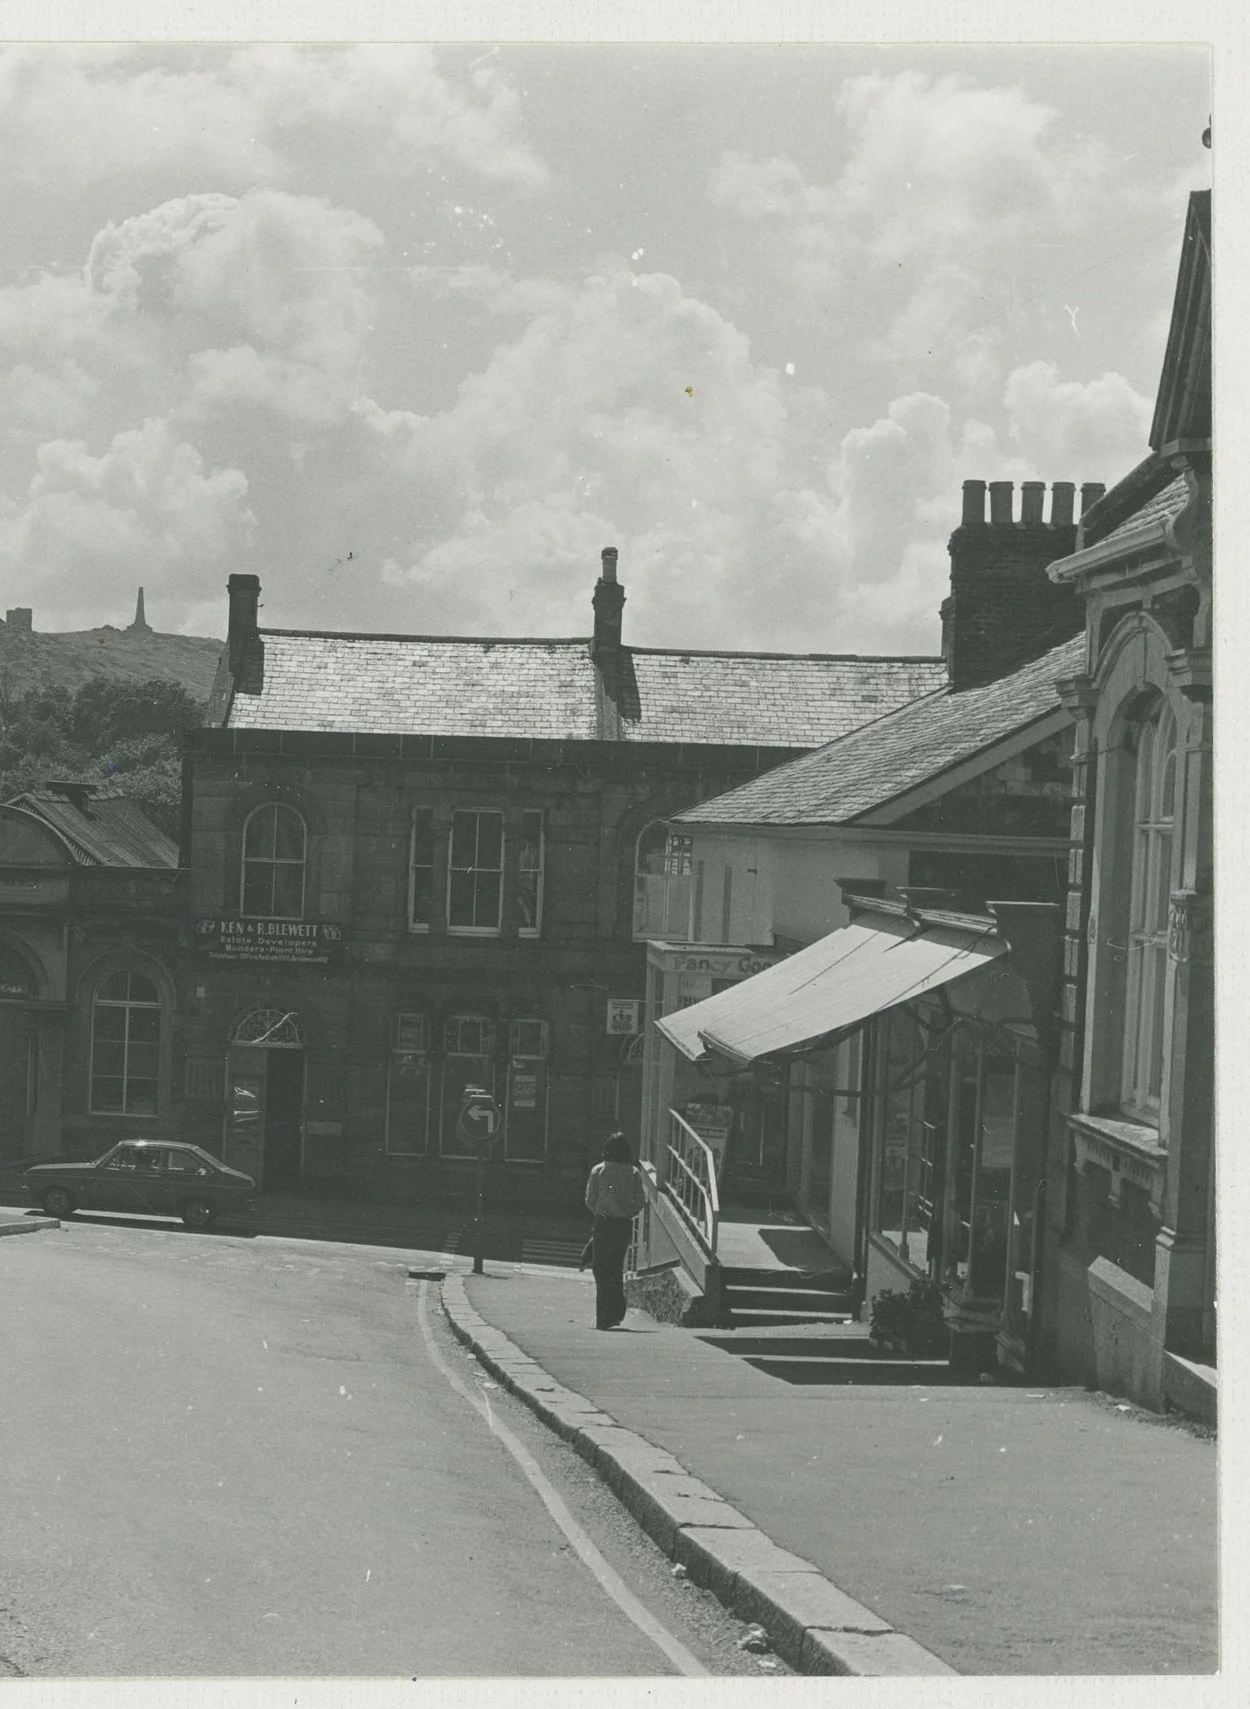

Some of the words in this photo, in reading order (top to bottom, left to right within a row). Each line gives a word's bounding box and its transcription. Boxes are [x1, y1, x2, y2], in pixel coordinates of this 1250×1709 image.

[221, 921, 244, 934] KEN
[247, 925, 254, 933] &
[257, 922, 318, 937] R.BLEWETT
[220, 936, 251, 944] Estate
[258, 937, 317, 947] Developers
[295, 947, 313, 955] Hire
[673, 956, 732, 974] Fancy
